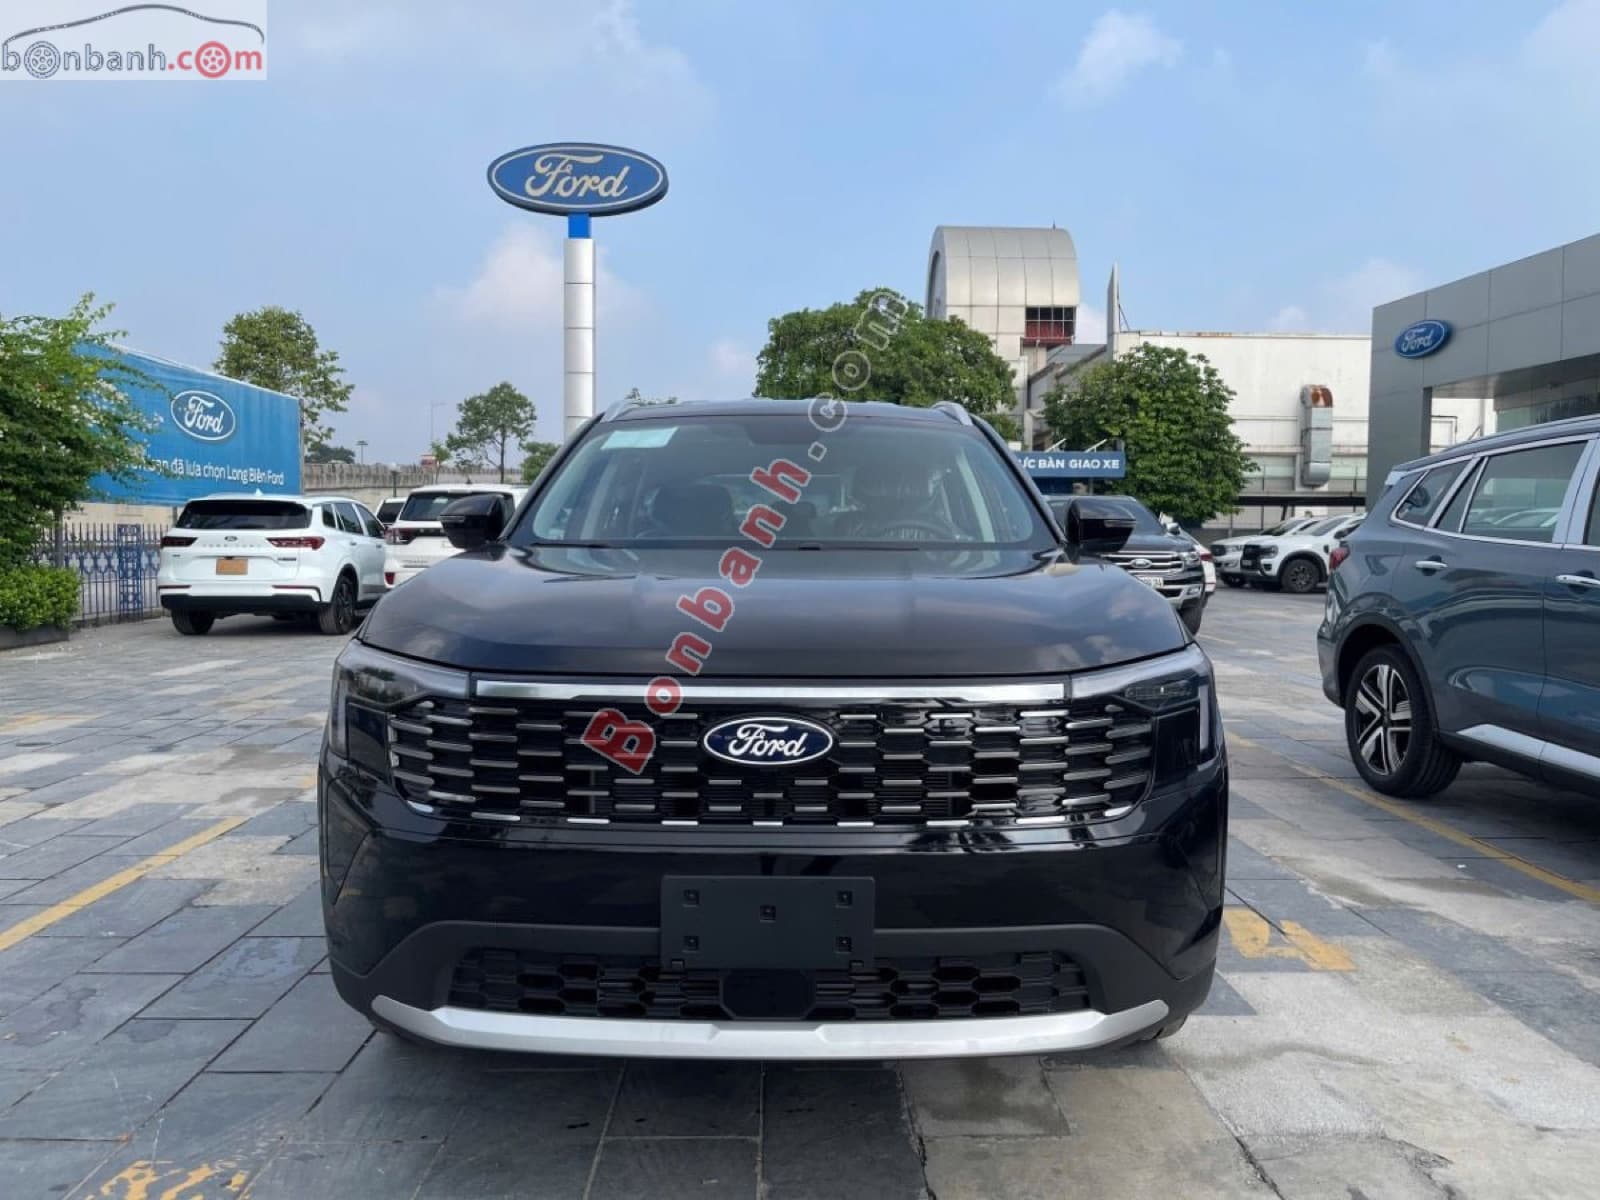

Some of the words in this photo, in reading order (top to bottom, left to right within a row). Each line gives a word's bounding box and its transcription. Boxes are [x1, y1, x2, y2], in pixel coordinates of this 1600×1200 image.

[525, 153, 630, 197] Ford
[1400, 327, 1434, 352] Ford
[184, 395, 225, 432] Ford
[227, 466, 250, 485] Long
[268, 470, 284, 485] Ford
[1038, 456, 1065, 469] BÀN
[1068, 459, 1100, 469] GIAO
[1103, 459, 1120, 469] XE
[728, 723, 808, 756] Ford
